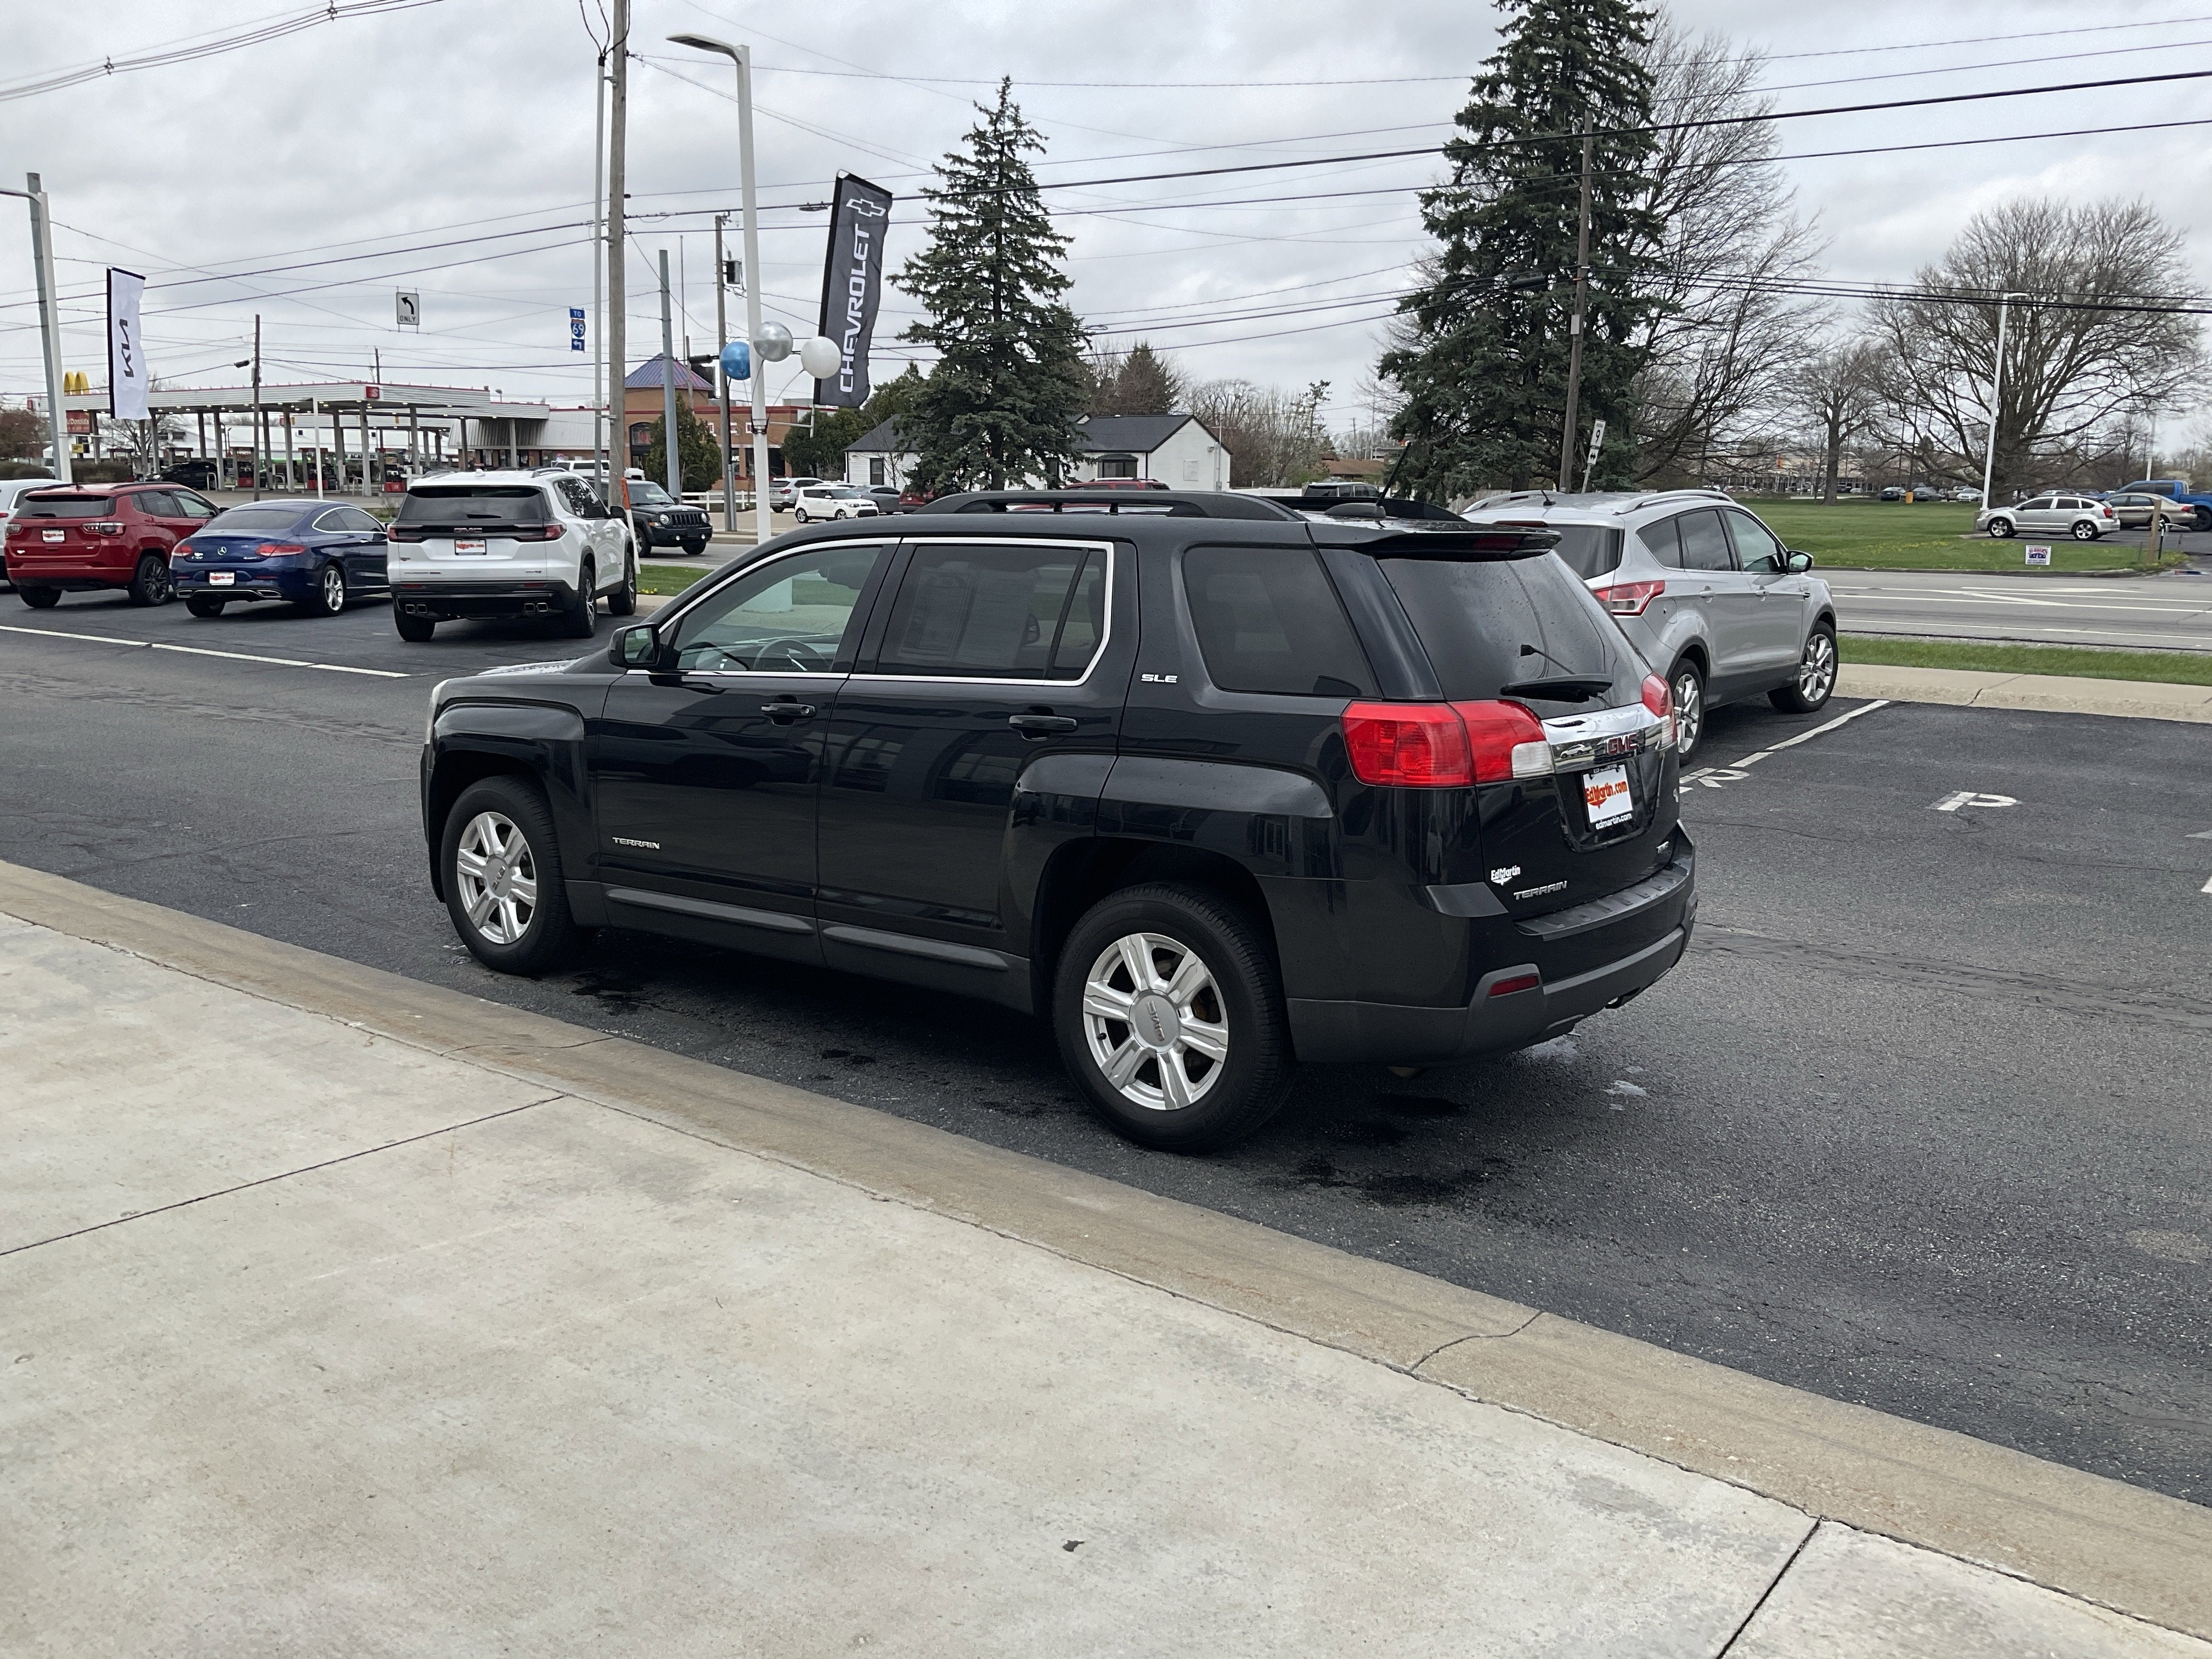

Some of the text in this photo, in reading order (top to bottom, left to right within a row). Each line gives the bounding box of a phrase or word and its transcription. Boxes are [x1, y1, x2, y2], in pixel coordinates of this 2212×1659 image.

[840, 223, 870, 393] CHEVROLET
[572, 324, 584, 335] 69
[1595, 430, 1600, 443] 9
[1141, 674, 1178, 683] SLE
[1606, 732, 1637, 755] GMC
[1595, 813, 1632, 830] edmartin.com
[612, 837, 661, 849] TERRAIN
[1513, 881, 1567, 900] TERRAIN
[1146, 1000, 1165, 1041] GMC
